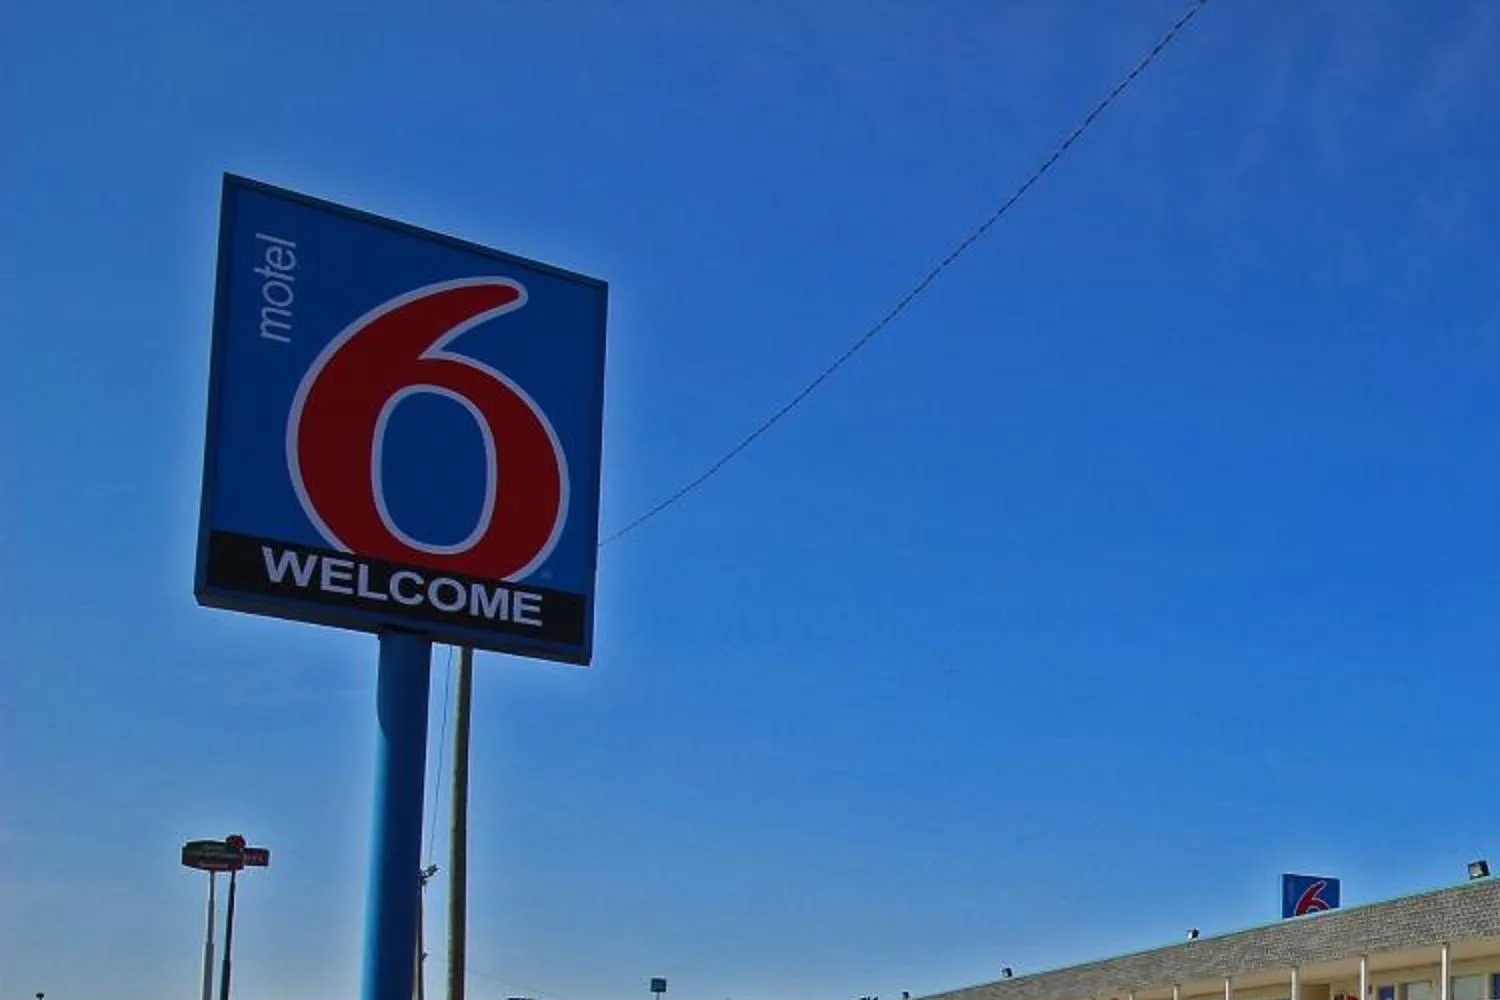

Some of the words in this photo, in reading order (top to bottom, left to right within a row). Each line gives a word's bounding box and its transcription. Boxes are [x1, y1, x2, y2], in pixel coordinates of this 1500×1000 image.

[253, 232, 297, 343] motel
[286, 276, 570, 582] 6
[261, 546, 543, 627] WELCOME
